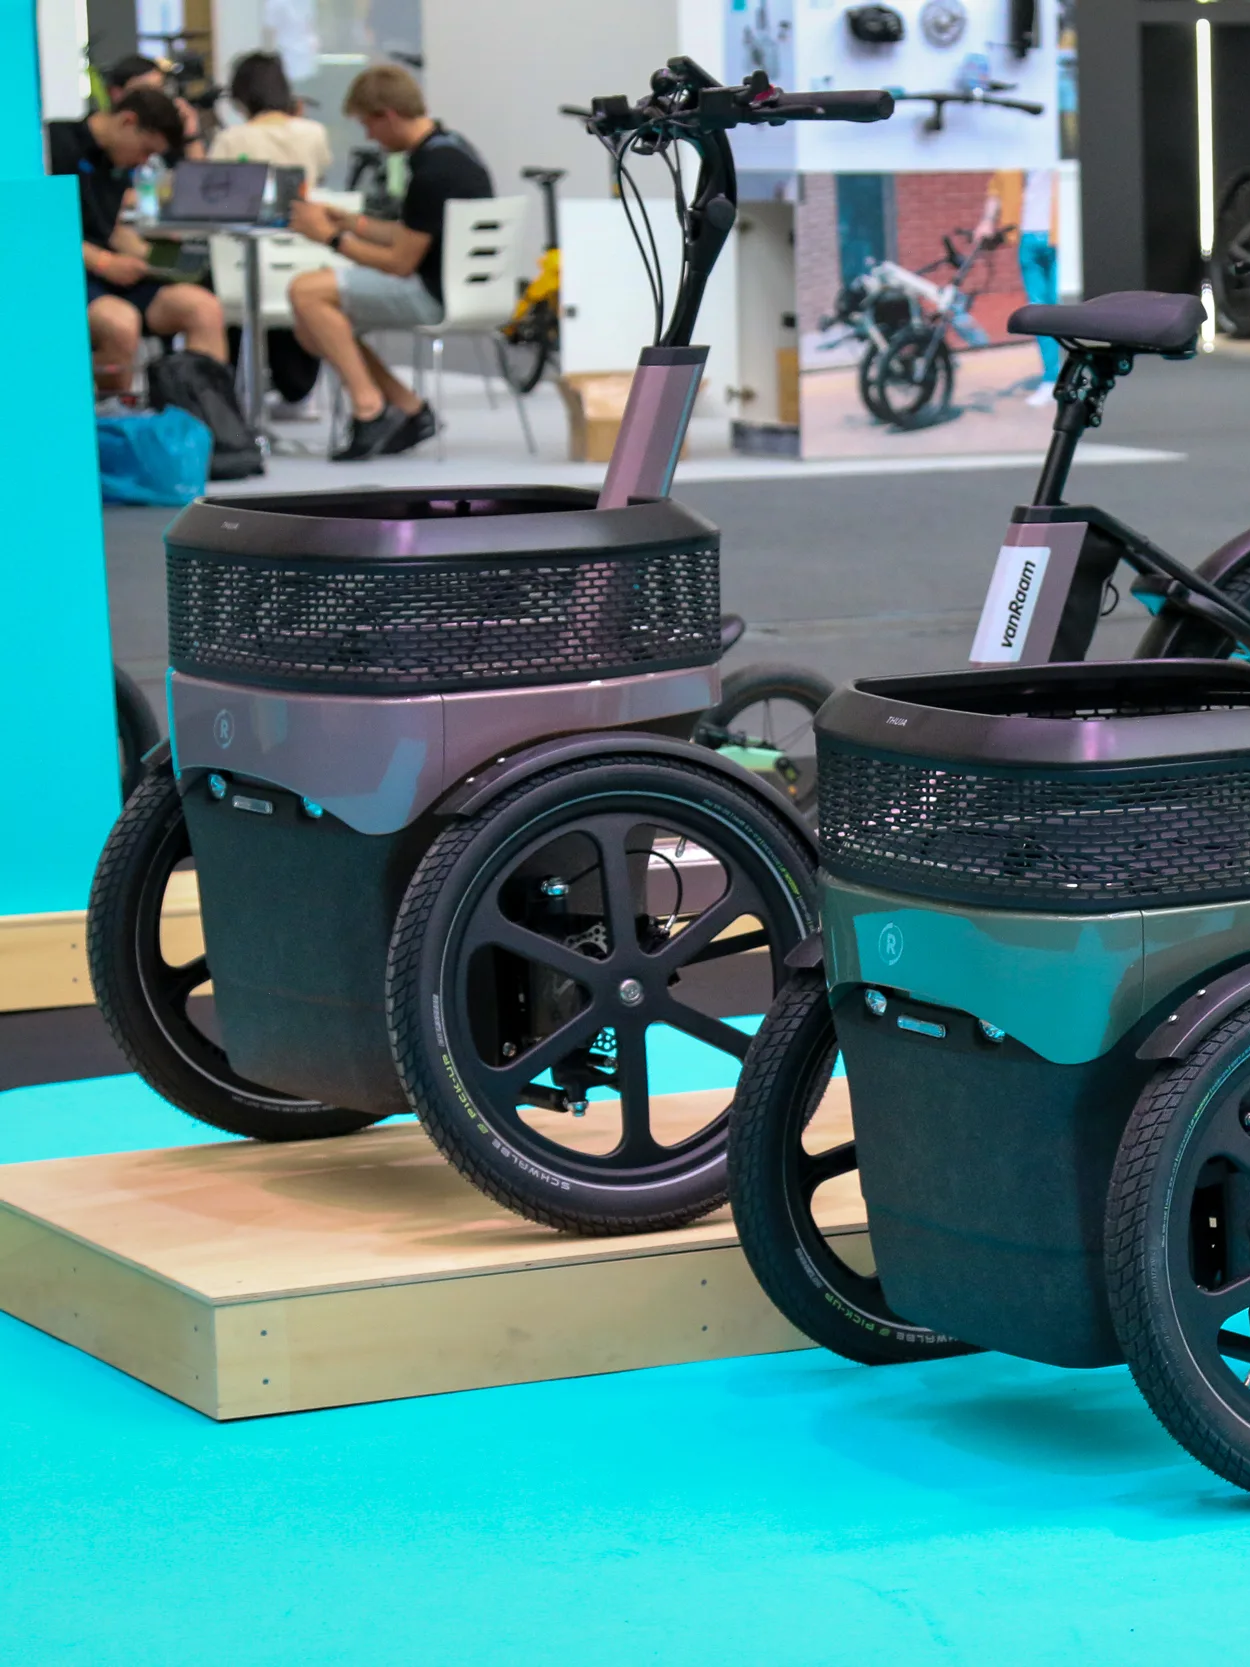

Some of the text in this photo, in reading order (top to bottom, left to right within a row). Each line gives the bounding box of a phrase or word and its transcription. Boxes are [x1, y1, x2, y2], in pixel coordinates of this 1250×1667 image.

[1001, 560, 1036, 648] vanRaam
[441, 1053, 571, 1191] SCHWALBE PICK-UP
[824, 1292, 876, 1331] PICK-UP
